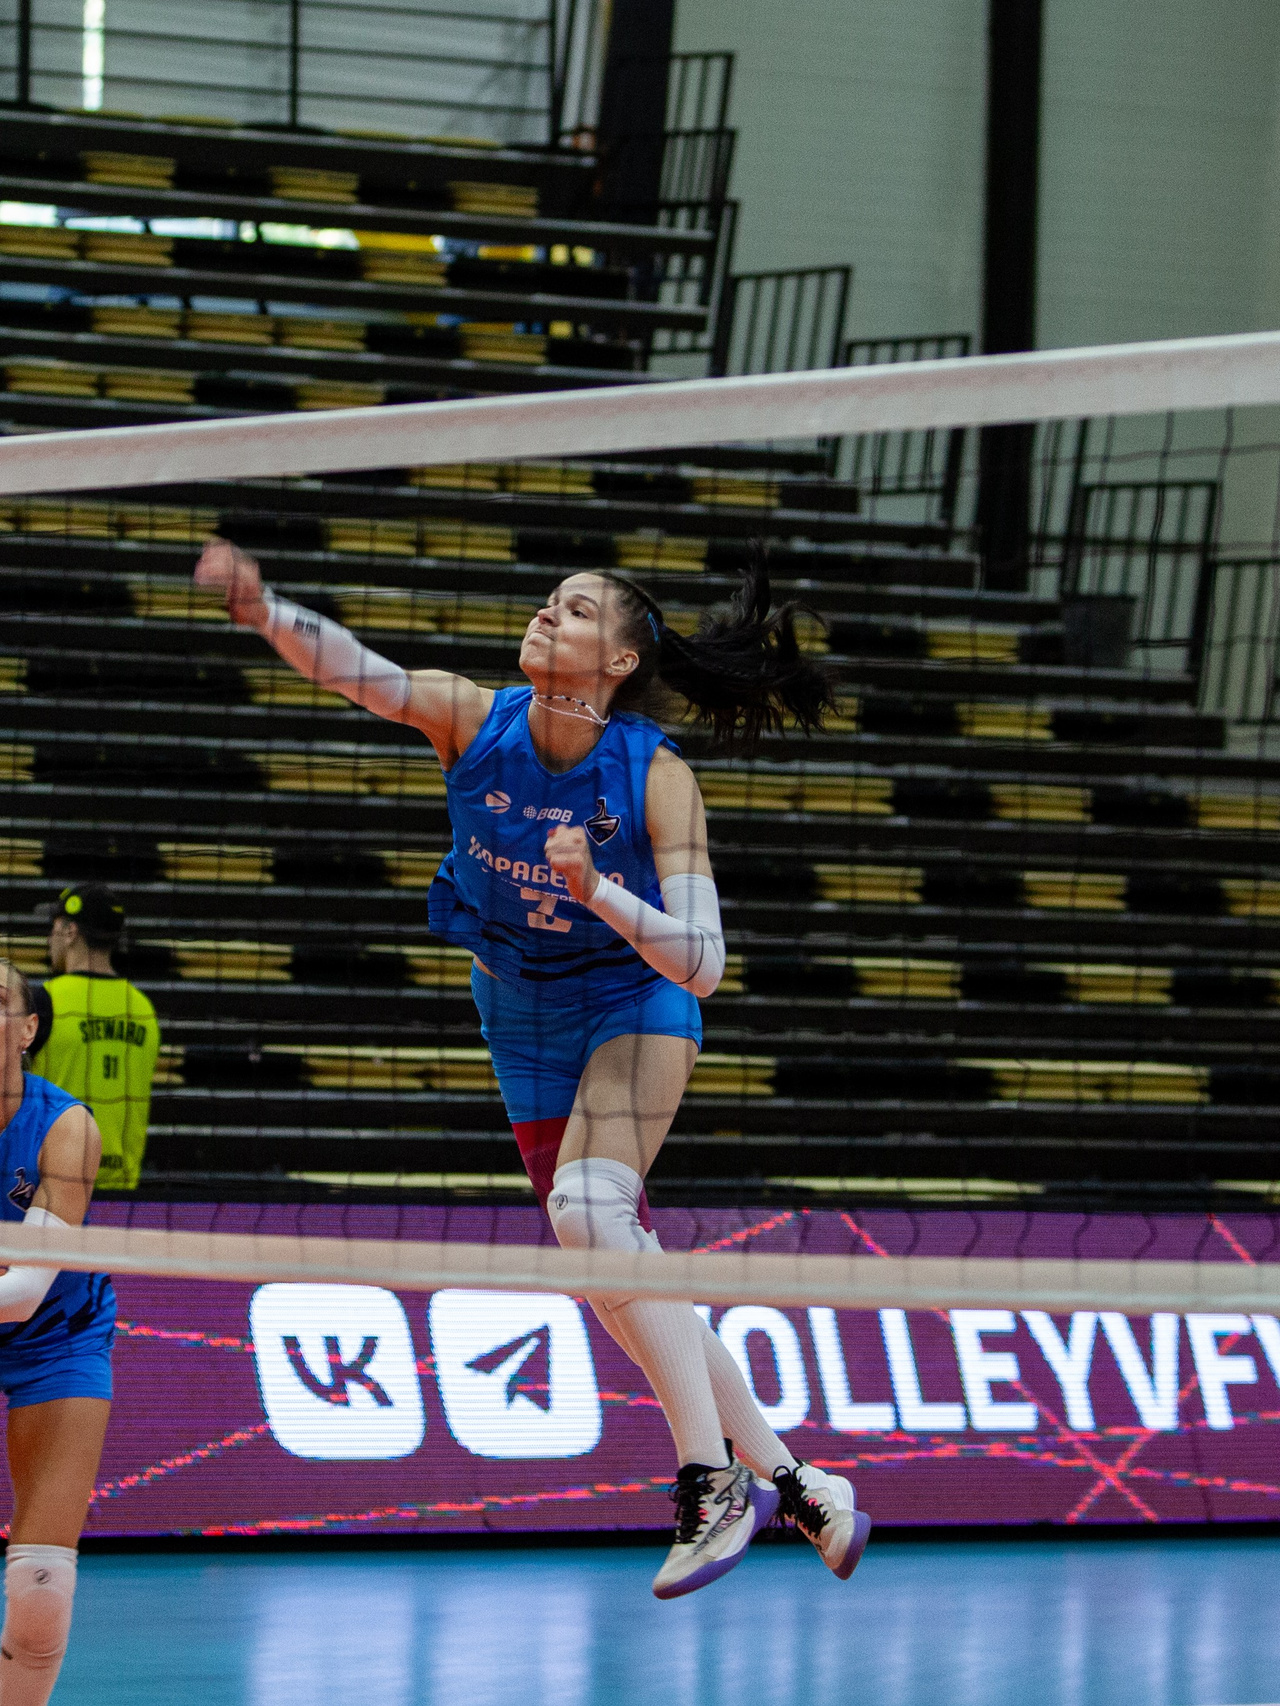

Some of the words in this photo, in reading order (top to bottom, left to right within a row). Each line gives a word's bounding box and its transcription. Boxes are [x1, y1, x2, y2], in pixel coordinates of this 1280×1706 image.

[537, 807, 574, 823] ВФВ
[79, 1018, 147, 1047] STEWARD
[694, 1304, 1280, 1432] OLLEYVF
